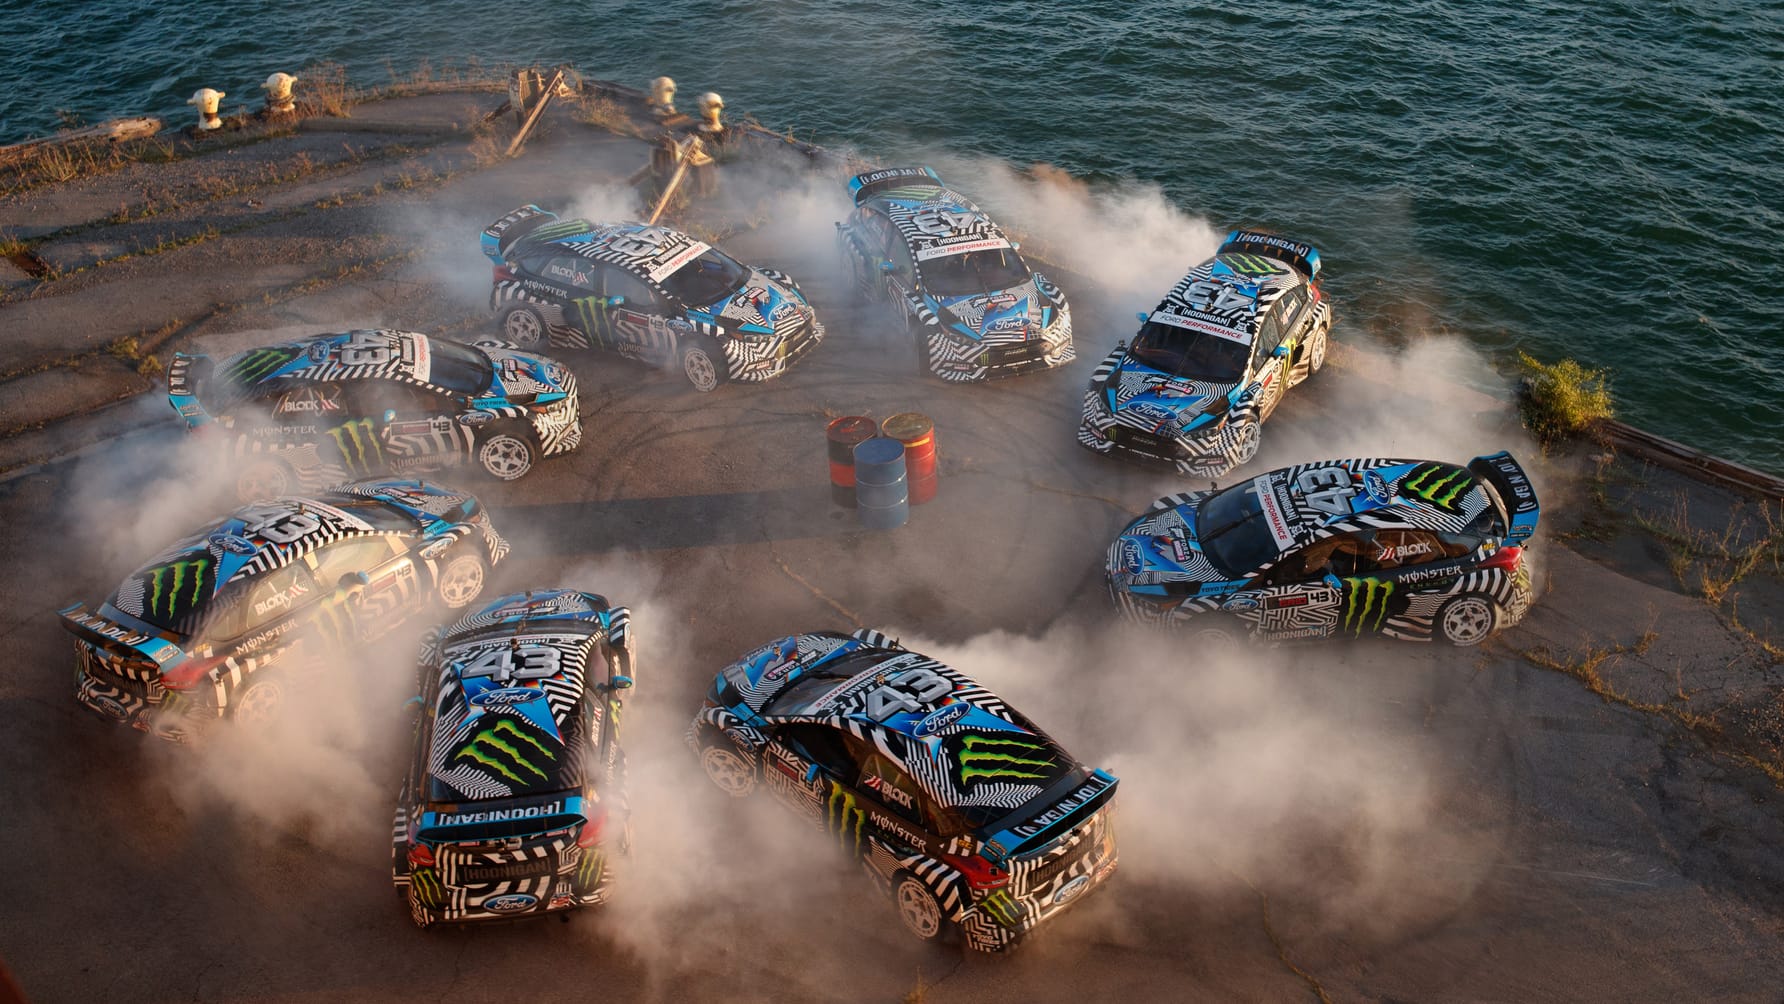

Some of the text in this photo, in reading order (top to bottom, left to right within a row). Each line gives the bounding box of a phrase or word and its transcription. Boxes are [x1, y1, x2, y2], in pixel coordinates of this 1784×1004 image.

[911, 210, 978, 235] 43
[947, 241, 1001, 253] PERFORMANCE
[524, 279, 567, 298] MONSTER
[1182, 282, 1253, 311] 43
[1181, 319, 1242, 340] PERFORMANCE
[285, 400, 318, 412] BLOCK
[253, 425, 317, 436] MONSTER
[432, 421, 451, 432] 43
[1298, 467, 1356, 516] 43
[1262, 493, 1288, 541] PERFORMANCE
[1396, 540, 1432, 557] BLOCK
[1398, 565, 1463, 584] MONSTER
[255, 589, 289, 615] BLOCK
[1310, 591, 1329, 602] 43
[236, 618, 299, 656] MONSTER
[461, 647, 561, 681] 43
[866, 668, 952, 722] 43
[881, 781, 913, 809] BLOCK
[870, 811, 927, 853] MONSTER
